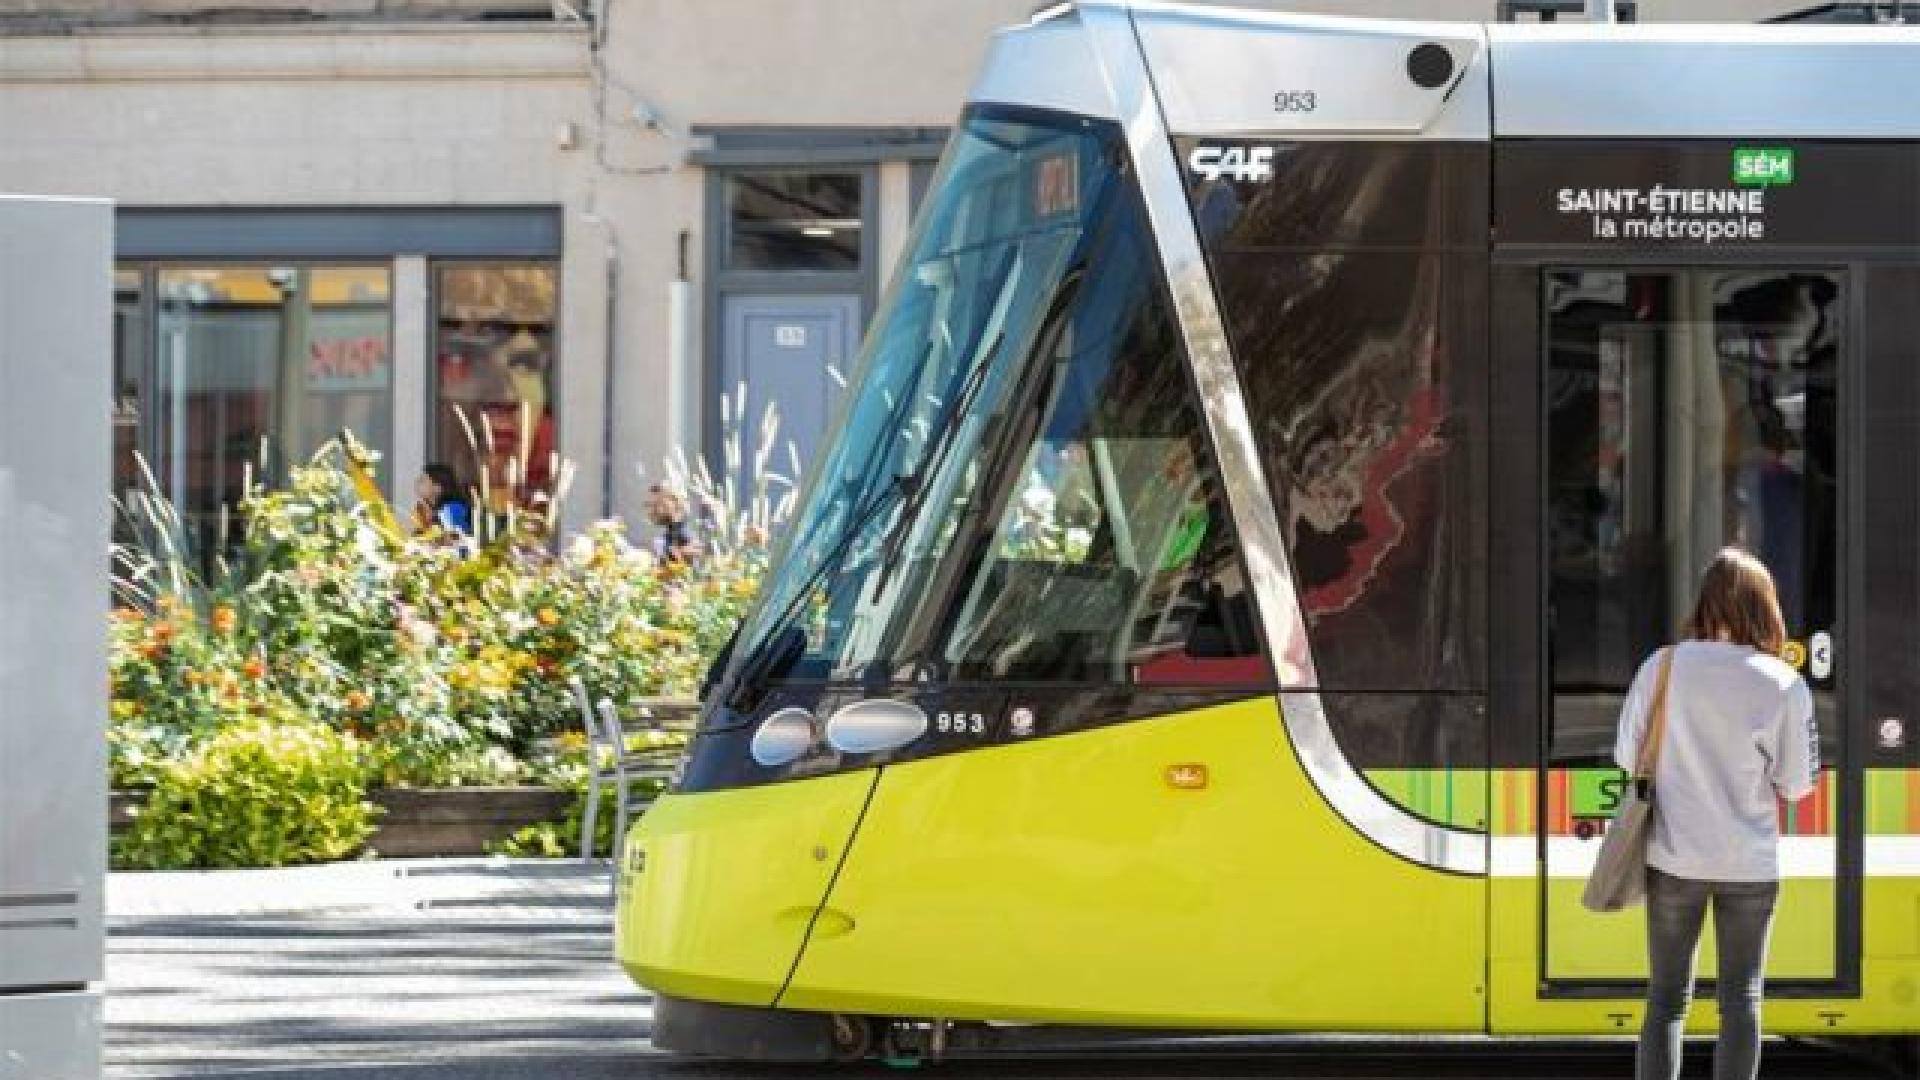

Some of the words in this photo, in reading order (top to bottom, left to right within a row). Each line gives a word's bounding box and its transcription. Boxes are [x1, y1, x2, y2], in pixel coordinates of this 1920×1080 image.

[1274, 90, 1318, 113] 953
[1738, 151, 1790, 176] SÉM
[1557, 183, 1765, 213] SAINT-ÉTIENNE
[1592, 214, 1618, 238] la
[1622, 214, 1765, 244] métropole
[937, 711, 984, 733] 953
